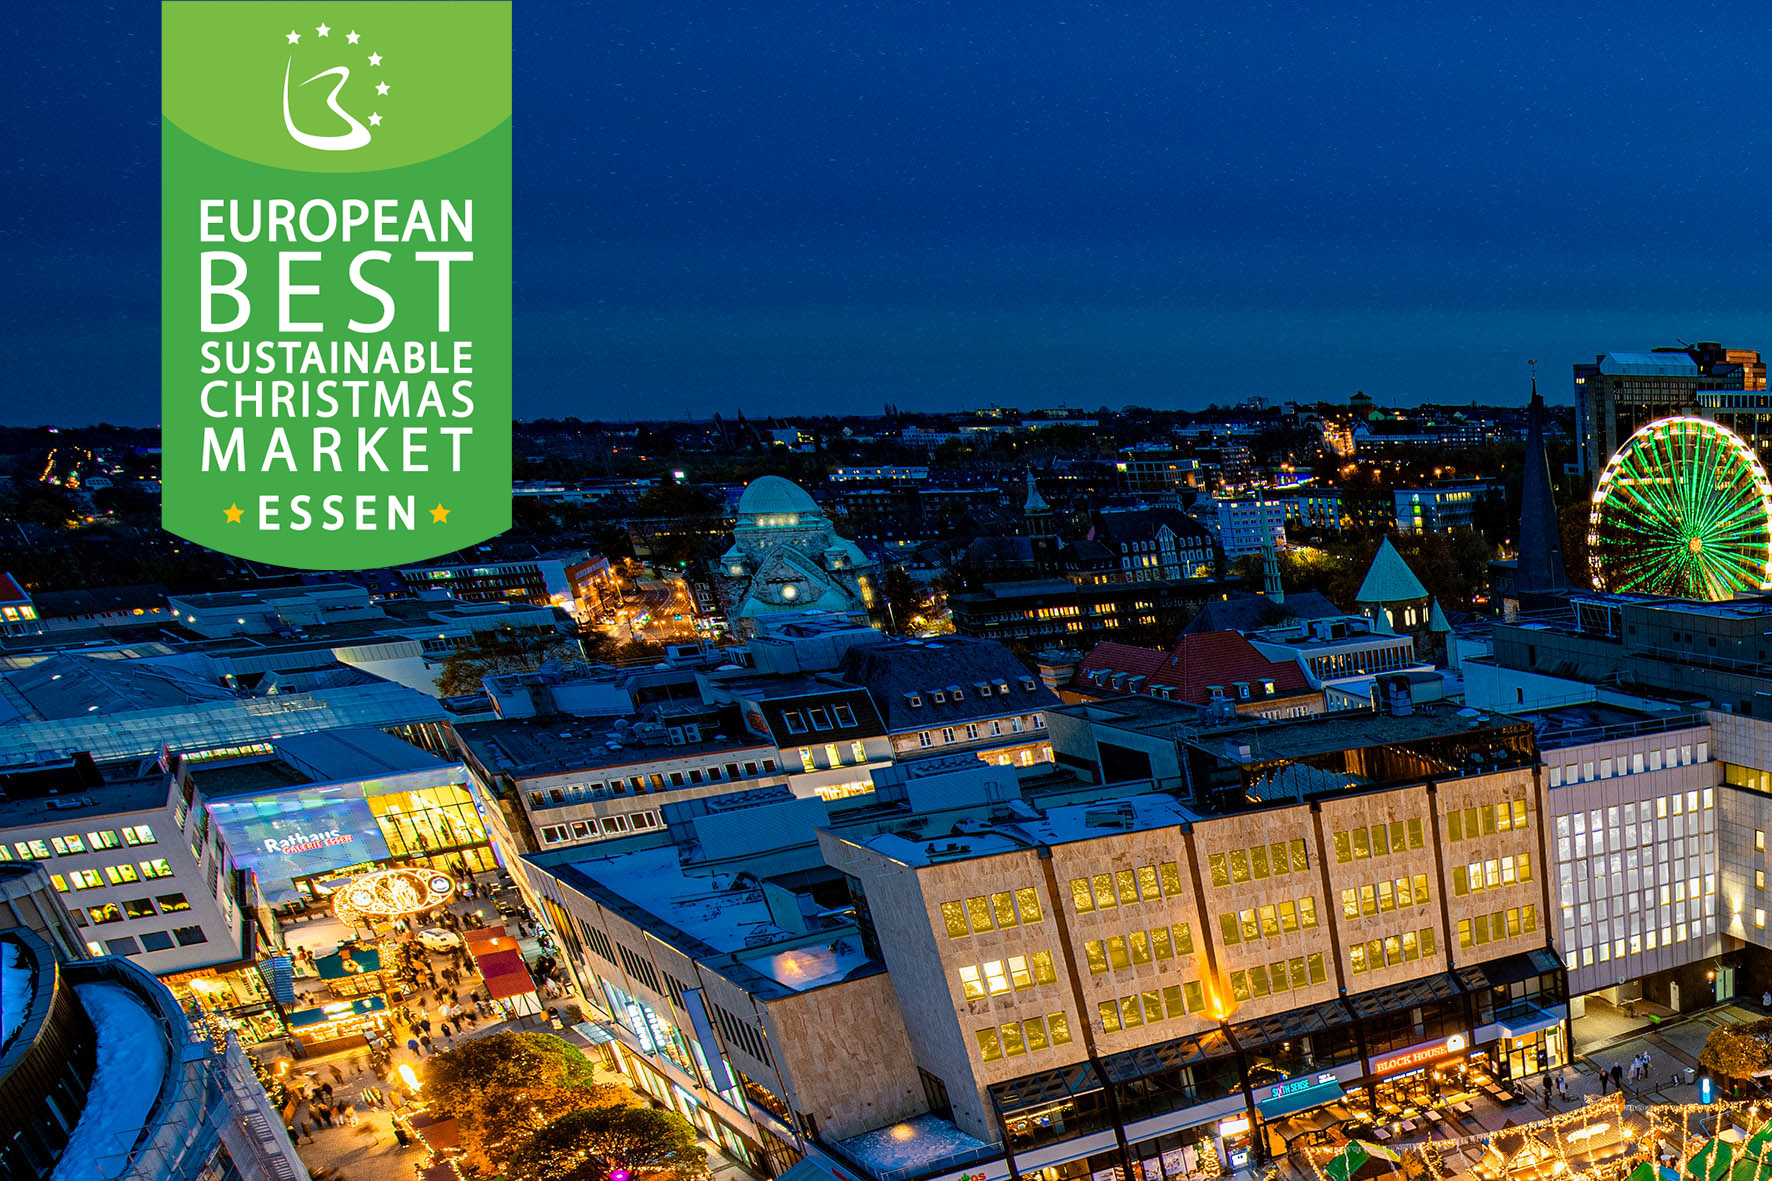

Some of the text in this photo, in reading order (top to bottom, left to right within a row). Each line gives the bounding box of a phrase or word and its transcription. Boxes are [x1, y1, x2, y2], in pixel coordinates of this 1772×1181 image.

[264, 829, 340, 853] Rathaus
[283, 834, 354, 854] GALERIE ESSEN
[1376, 1045, 1447, 1072] BLOCK HOUSE
[1290, 1079, 1309, 1094] SENSE
